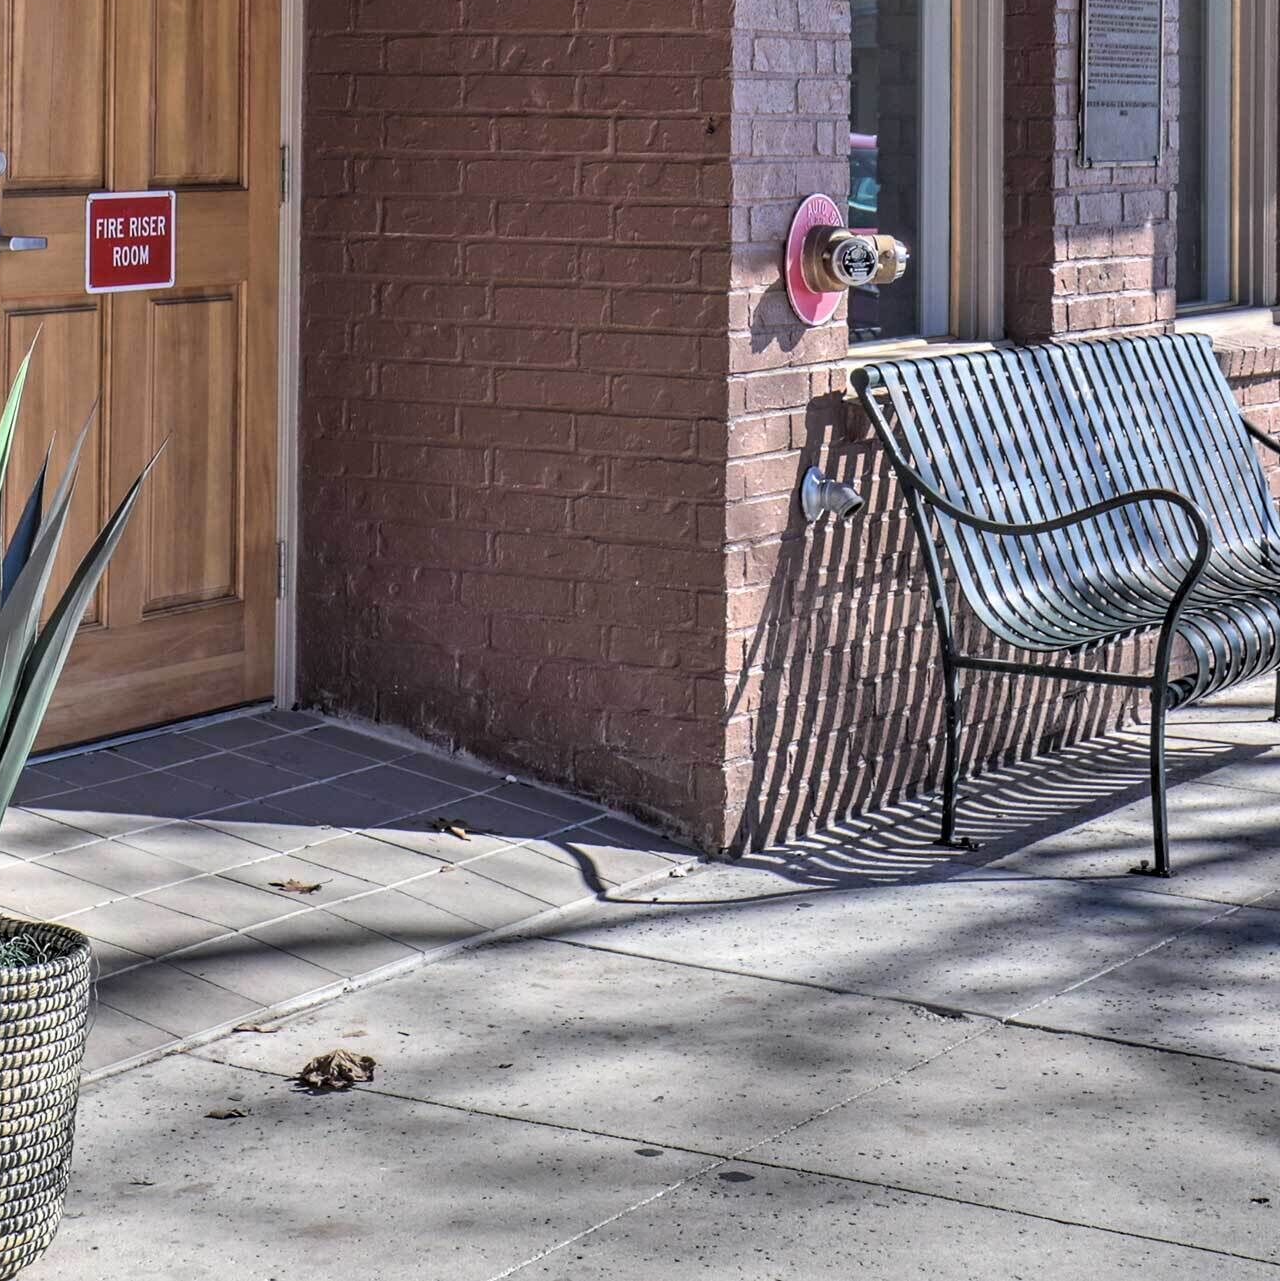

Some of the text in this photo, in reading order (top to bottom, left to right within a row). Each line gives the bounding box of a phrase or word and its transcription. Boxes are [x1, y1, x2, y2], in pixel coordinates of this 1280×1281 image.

[96, 215, 166, 239] FIRE RISER
[112, 245, 150, 267] ROOM
